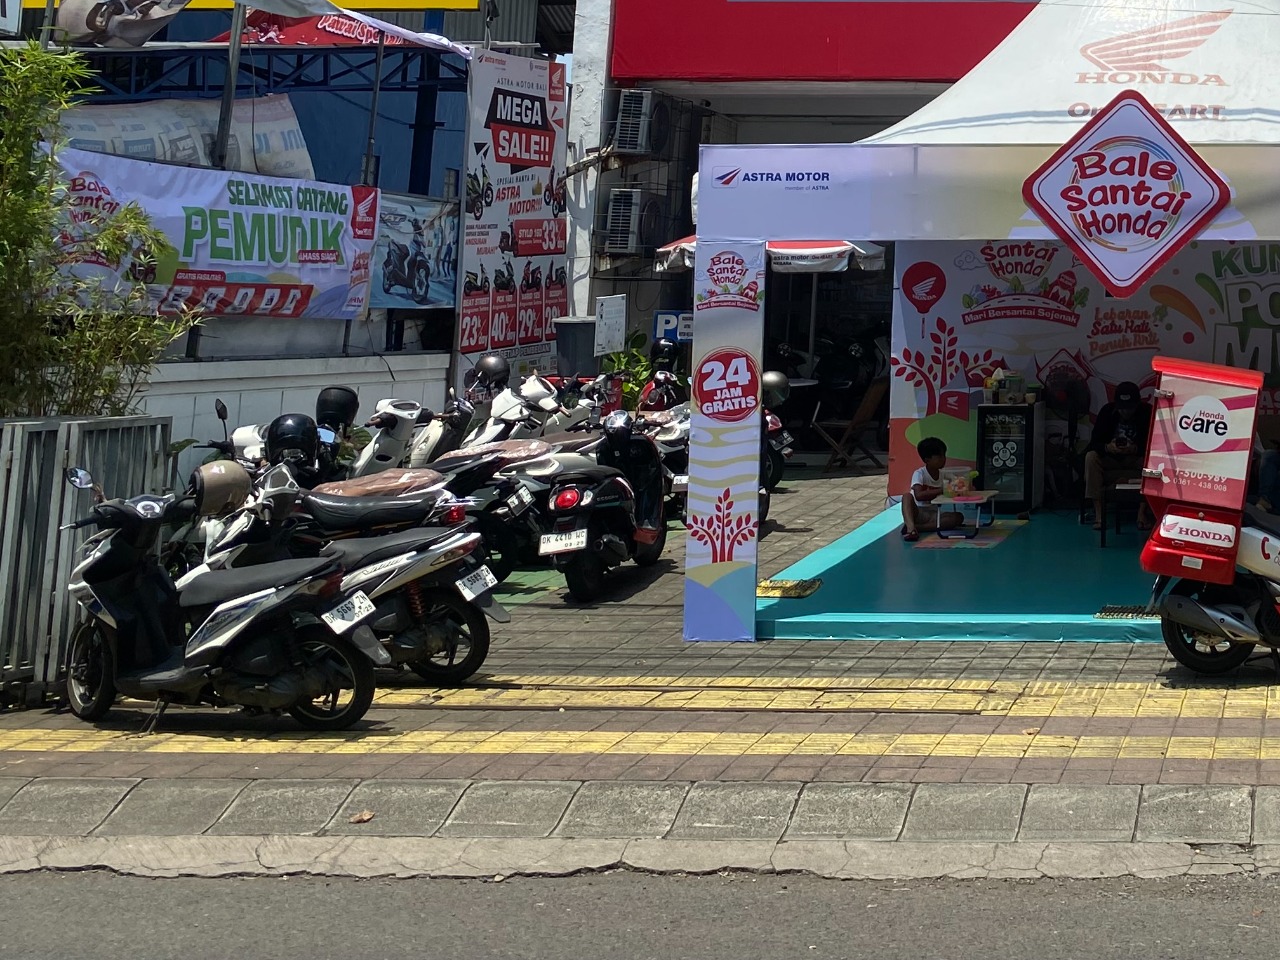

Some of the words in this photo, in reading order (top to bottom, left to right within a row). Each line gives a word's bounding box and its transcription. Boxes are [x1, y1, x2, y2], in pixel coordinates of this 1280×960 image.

[497, 77, 514, 87] ASTRA
[516, 80, 534, 89] MOTOR
[1075, 71, 1231, 86] HONDA
[496, 94, 542, 125] MEGA
[1153, 103, 1228, 121] EART.
[498, 130, 549, 161] SALE!!
[1072, 151, 1177, 180] Bale
[742, 172, 782, 181] ASTRA
[785, 172, 830, 181] MOTOR
[70, 177, 111, 196] Bale
[496, 185, 521, 201] ASTRA
[227, 179, 294, 209] SELAMAT
[297, 185, 349, 215] DATANG
[1060, 180, 1192, 215] Santai
[1079, 210, 1168, 240] Honda
[182, 206, 346, 266] PEMUDIK
[980, 241, 1059, 262] Santai
[710, 256, 744, 267] Bale
[993, 259, 1045, 277] Honda
[707, 266, 749, 277] Santai
[713, 275, 741, 286] Honda
[965, 311, 987, 323] Mari
[988, 309, 1036, 318] Bersantai
[656, 314, 677, 338] P
[1091, 320, 1122, 335] Satu
[1125, 320, 1150, 333] Hati
[702, 357, 751, 391] 24
[714, 387, 742, 400] JAM
[702, 396, 756, 414] GRATIS
[1200, 410, 1224, 420] Honda
[1198, 481, 1212, 490] 438
[1214, 483, 1227, 492] 008
[542, 535, 551, 544] DK
[576, 530, 585, 539] WC
[1178, 526, 1232, 543] HONDA
